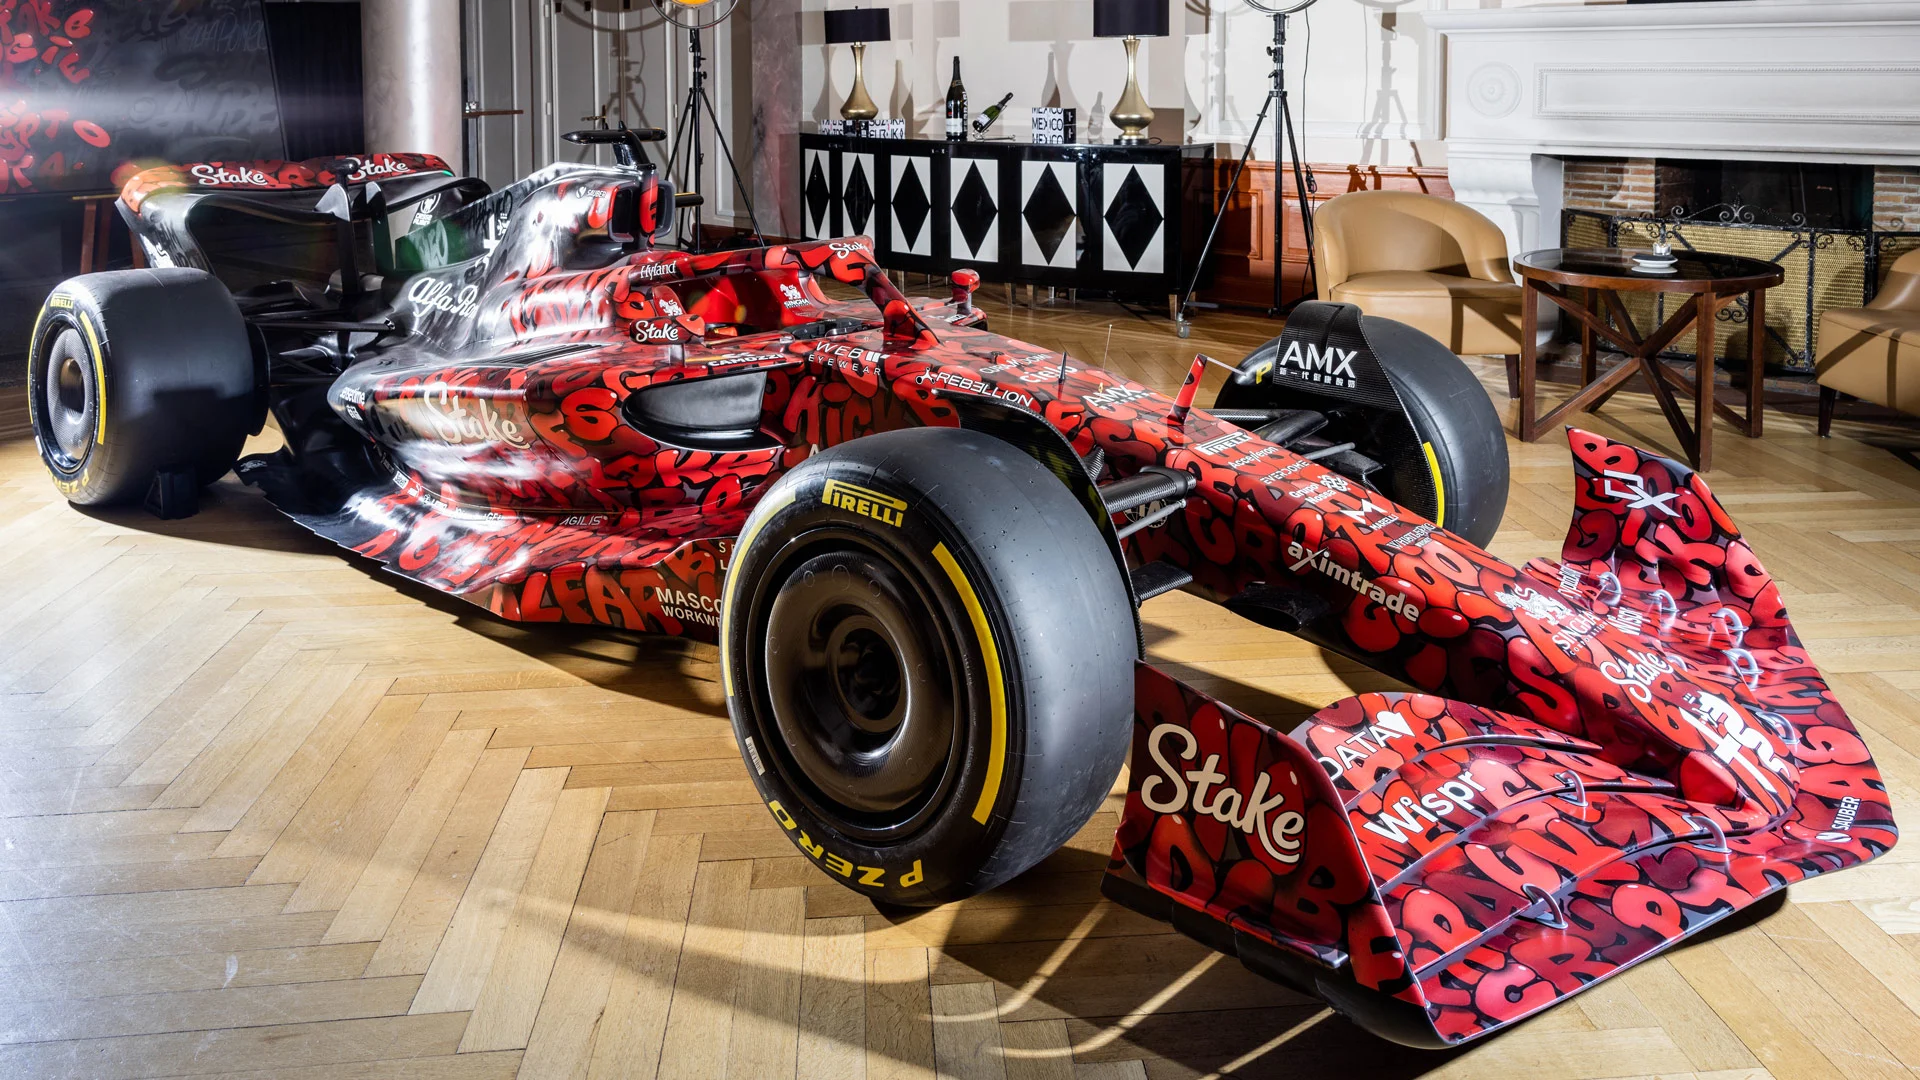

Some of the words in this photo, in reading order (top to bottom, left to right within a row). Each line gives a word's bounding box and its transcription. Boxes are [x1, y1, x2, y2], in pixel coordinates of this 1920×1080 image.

[1032, 118, 1063, 131] MEXICO
[190, 164, 269, 187] Stake
[347, 157, 410, 181] Stake
[640, 260, 677, 279] Hyland
[635, 319, 679, 343] Stake
[707, 354, 785, 367] CAMOZZI
[816, 341, 864, 359] WEB
[1279, 340, 1358, 379] AMX
[808, 354, 881, 376] EYEWEAR
[1082, 384, 1142, 407] AMX
[424, 381, 532, 450] Stake
[1193, 431, 1252, 456] PIRELLI
[1260, 460, 1310, 485] EVERDOME
[821, 478, 908, 528] PIRELLI
[1288, 483, 1320, 498] Grupo
[1305, 489, 1337, 506] Nossa
[559, 515, 603, 526] AGILIS
[1287, 541, 1420, 622] aximtrade
[1552, 610, 1600, 650] SINGHA
[1600, 649, 1674, 703] Stake
[1141, 723, 1305, 863] Stake
[1366, 770, 1487, 844] Wispr
[1832, 796, 1861, 831] SAUBER
[768, 800, 886, 888] ZERO
[899, 859, 924, 888] P
